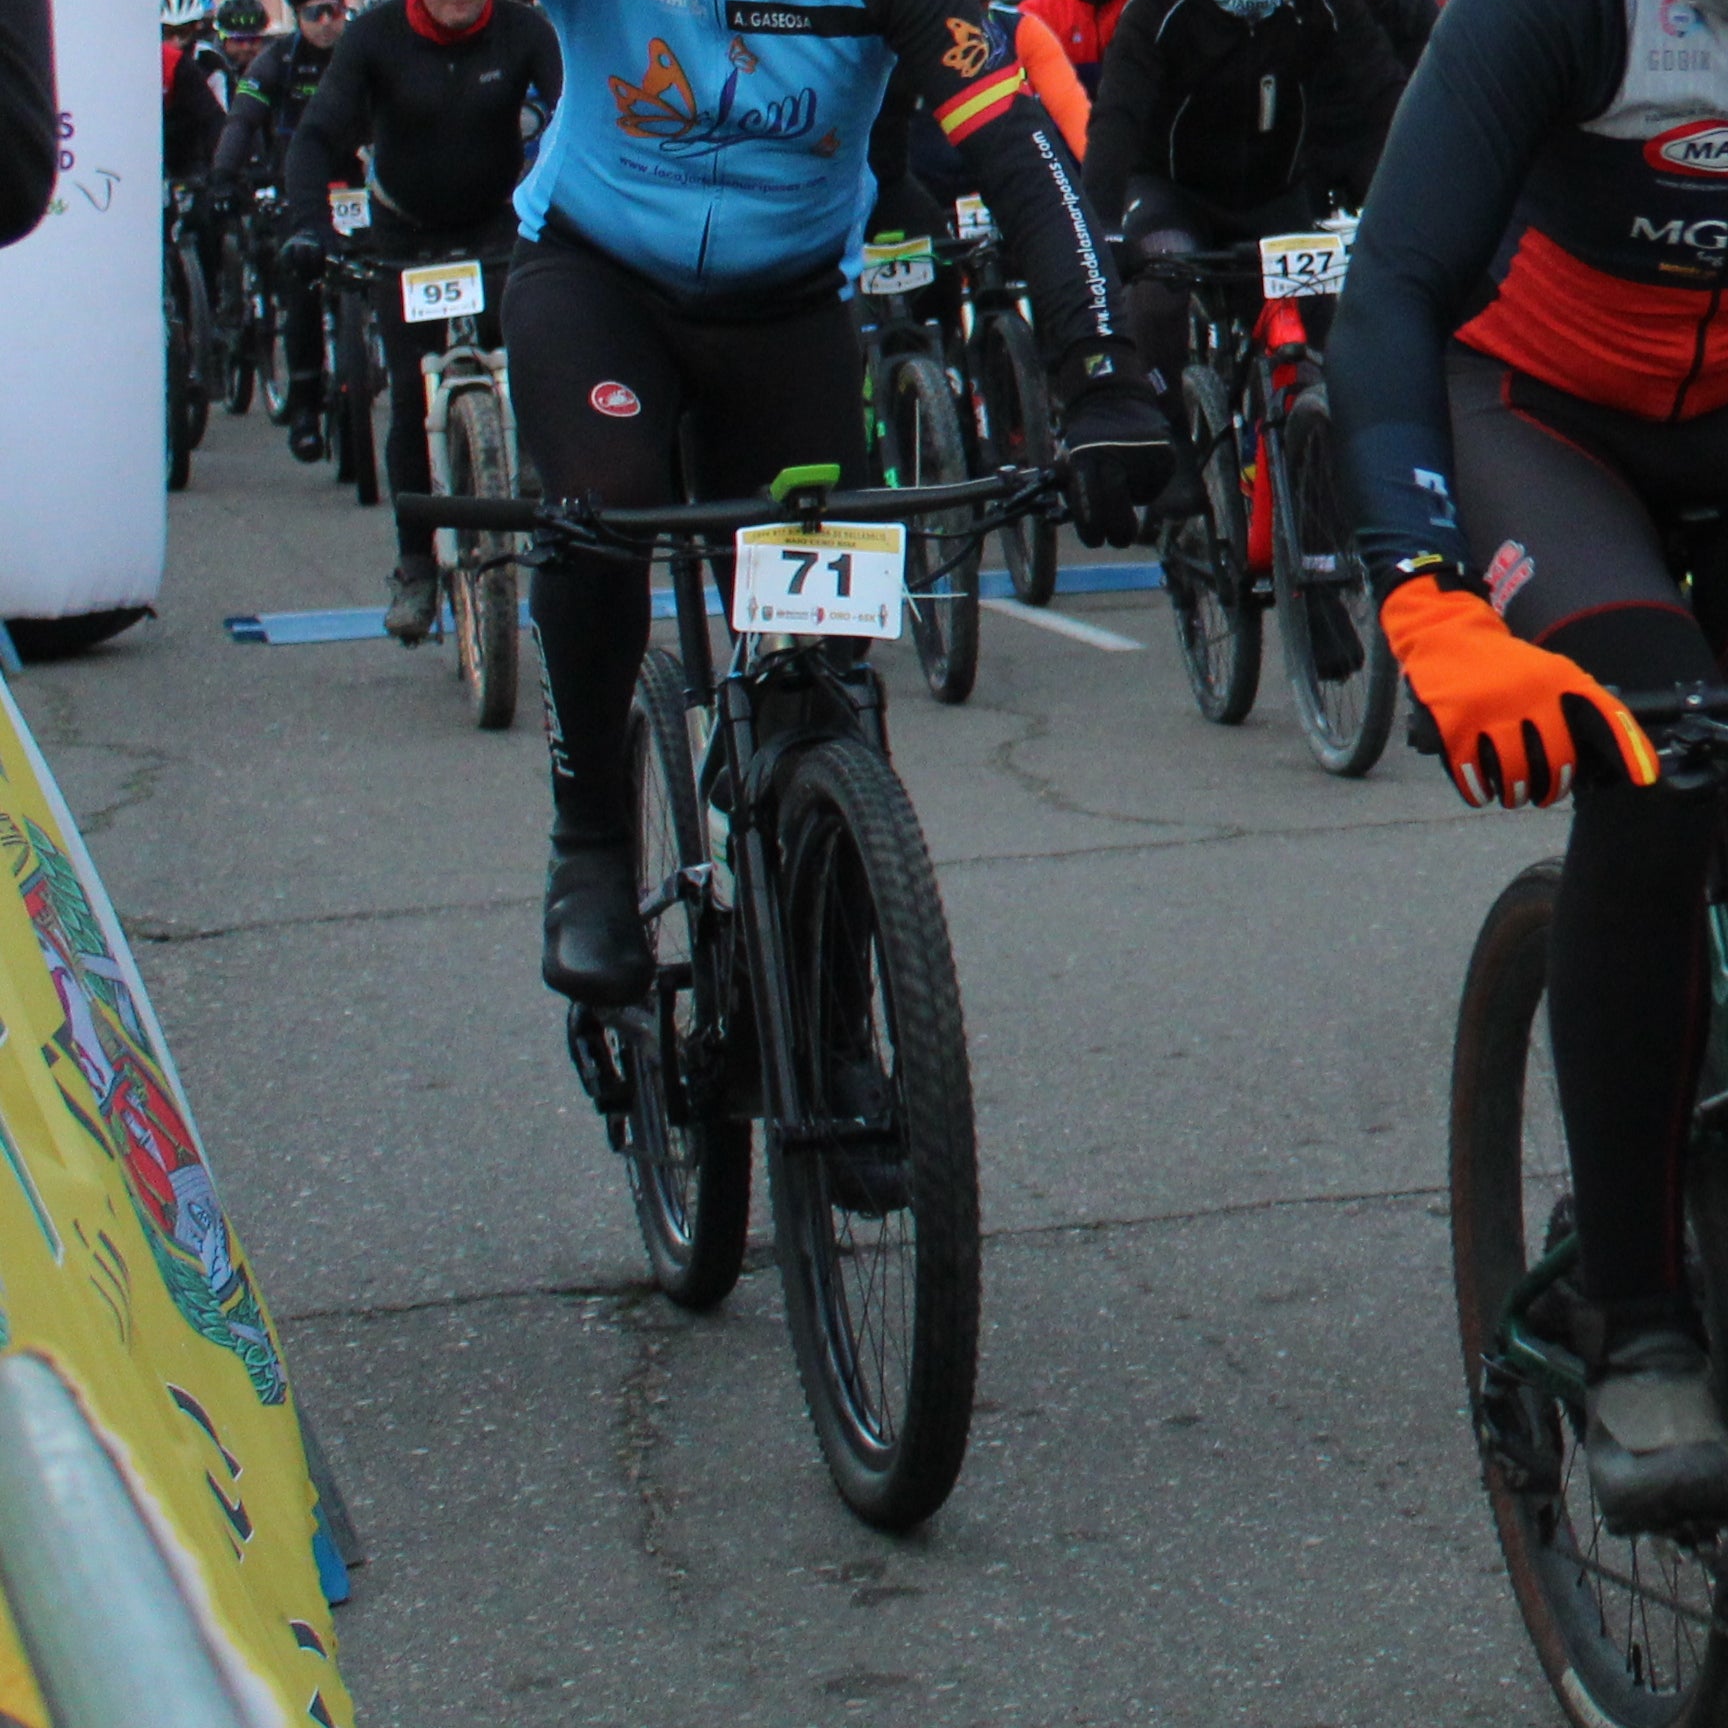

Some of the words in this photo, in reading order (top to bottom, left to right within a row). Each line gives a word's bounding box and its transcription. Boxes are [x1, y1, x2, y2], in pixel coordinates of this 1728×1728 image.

[1274, 250, 1335, 278] 127
[423, 280, 463, 305] 95
[782, 550, 853, 598] 71
